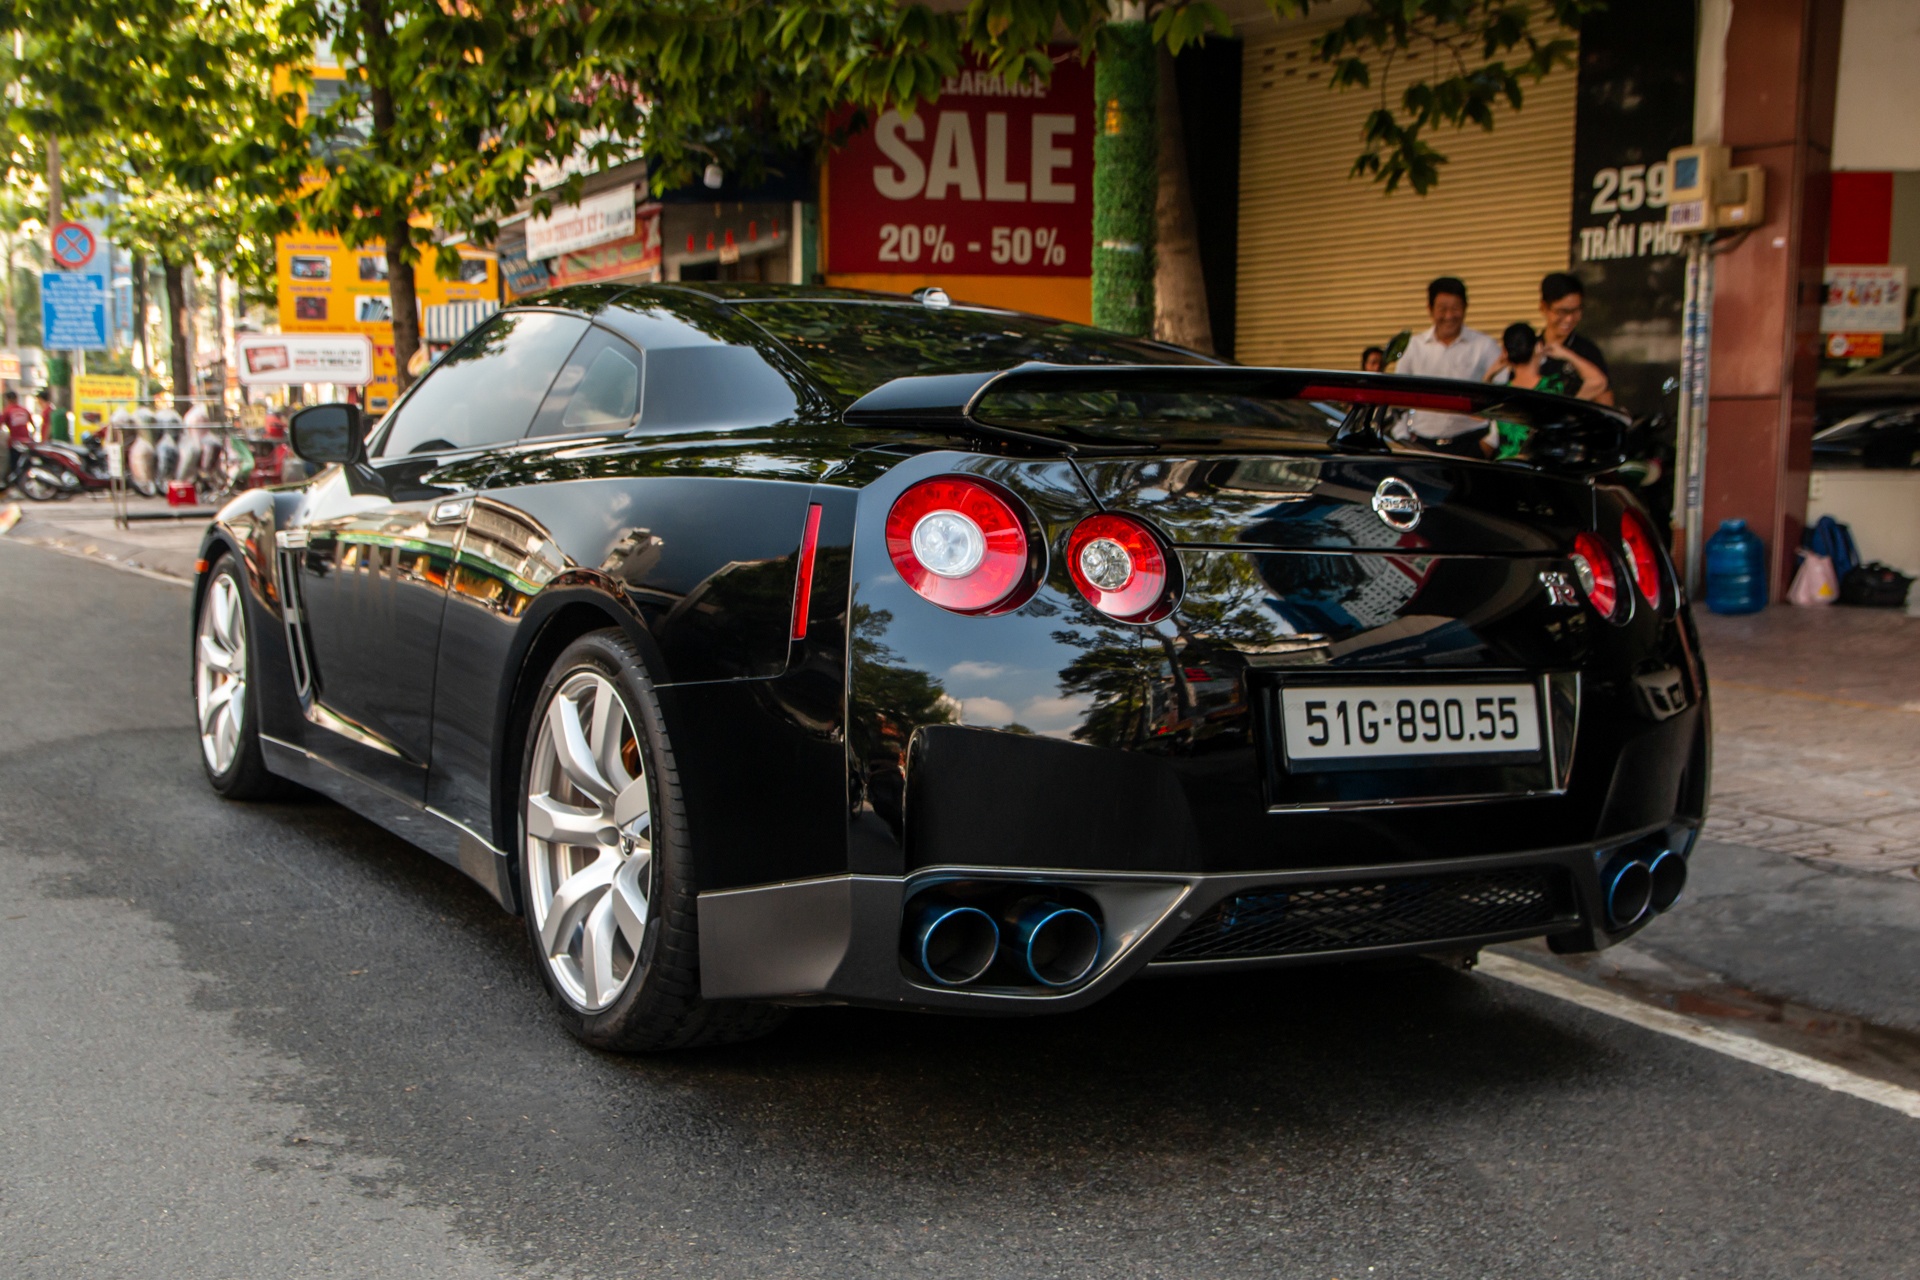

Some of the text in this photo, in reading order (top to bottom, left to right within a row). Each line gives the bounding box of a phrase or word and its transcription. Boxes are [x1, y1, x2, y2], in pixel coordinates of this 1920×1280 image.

[873, 110, 1076, 203] SALE
[1590, 161, 1668, 214] 259
[878, 223, 955, 264] 20%
[991, 226, 1066, 266] 50%
[1305, 696, 1520, 747] 51G-890.55
